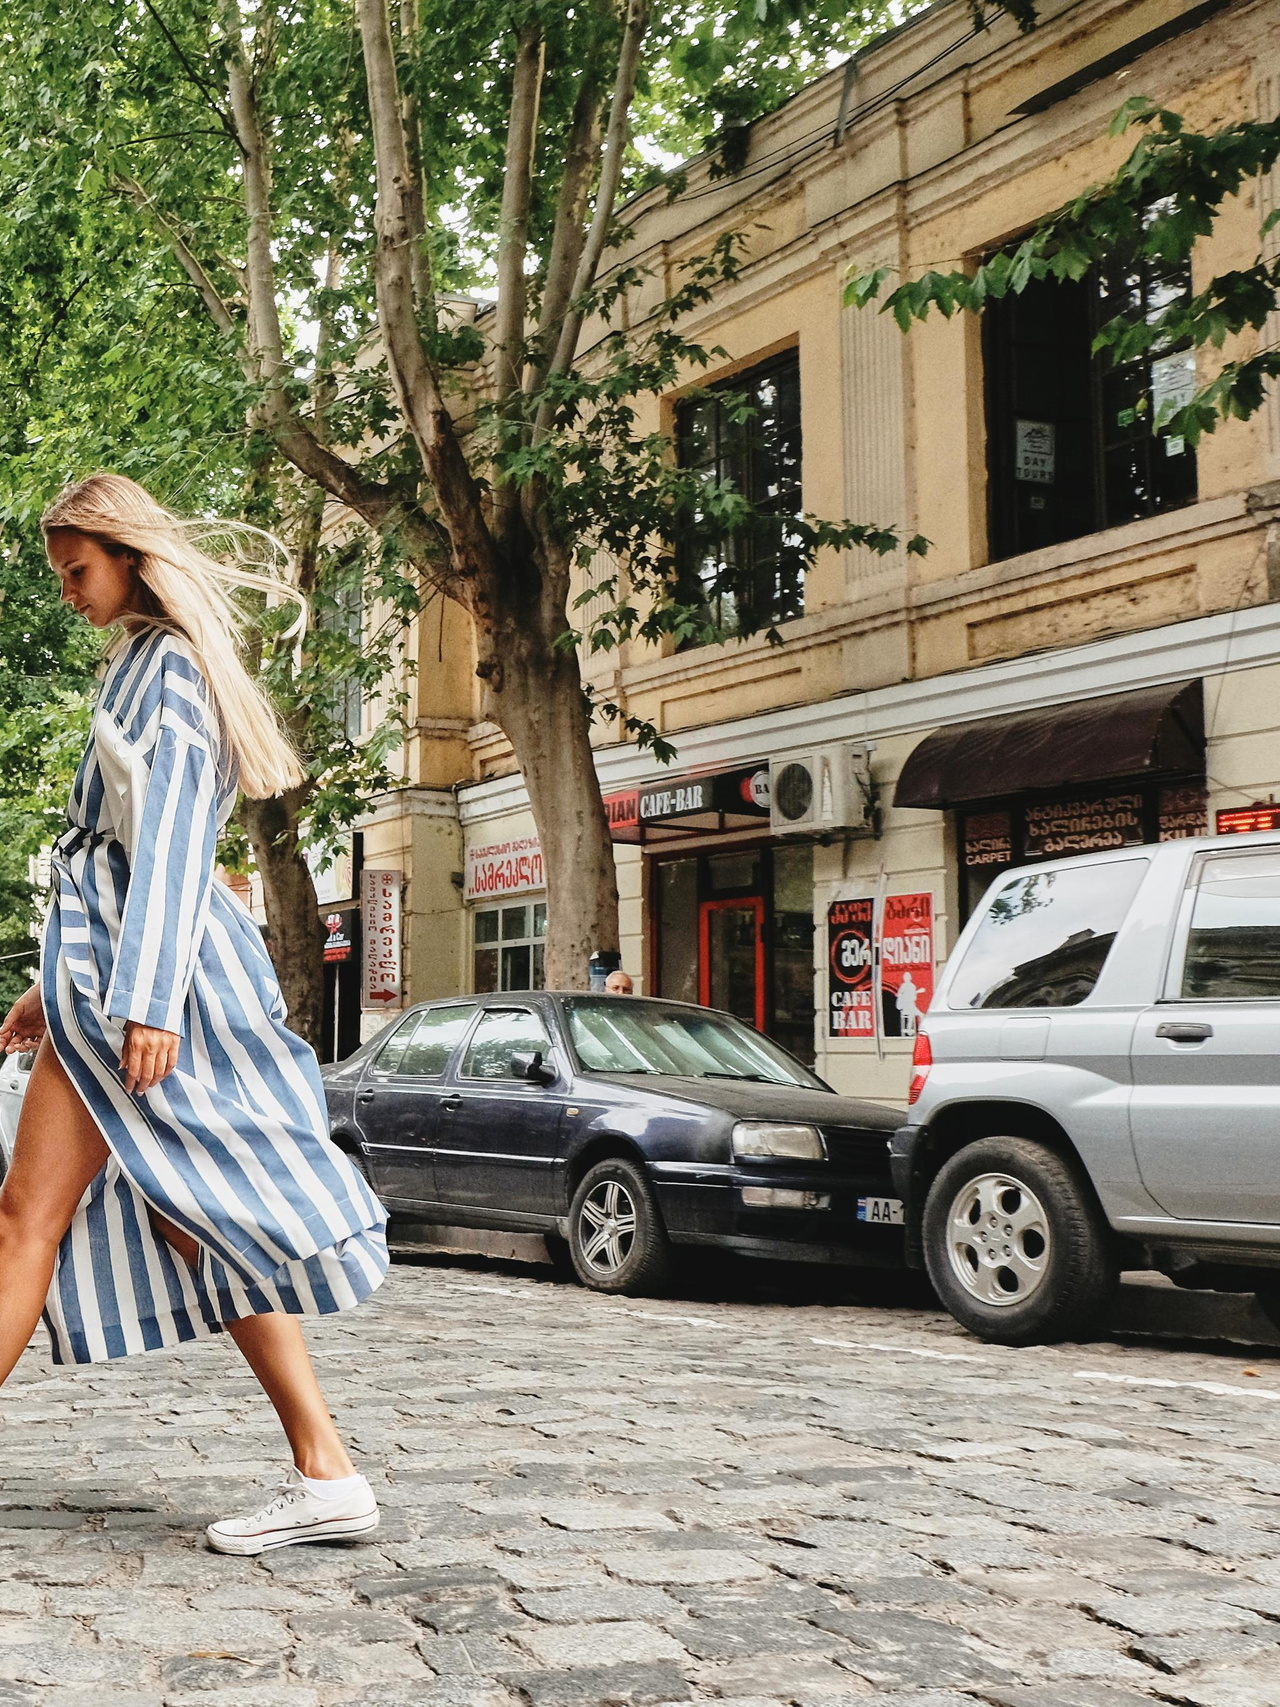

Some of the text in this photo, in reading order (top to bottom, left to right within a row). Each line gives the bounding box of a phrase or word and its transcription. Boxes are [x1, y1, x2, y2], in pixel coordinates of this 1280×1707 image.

[1024, 456, 1046, 467] DAY
[1016, 467, 1053, 480] TOURS
[754, 783, 770, 795] BA
[966, 851, 1011, 866] CARPET
[831, 991, 871, 1007] CAFE
[832, 1010, 872, 1029] BAR
